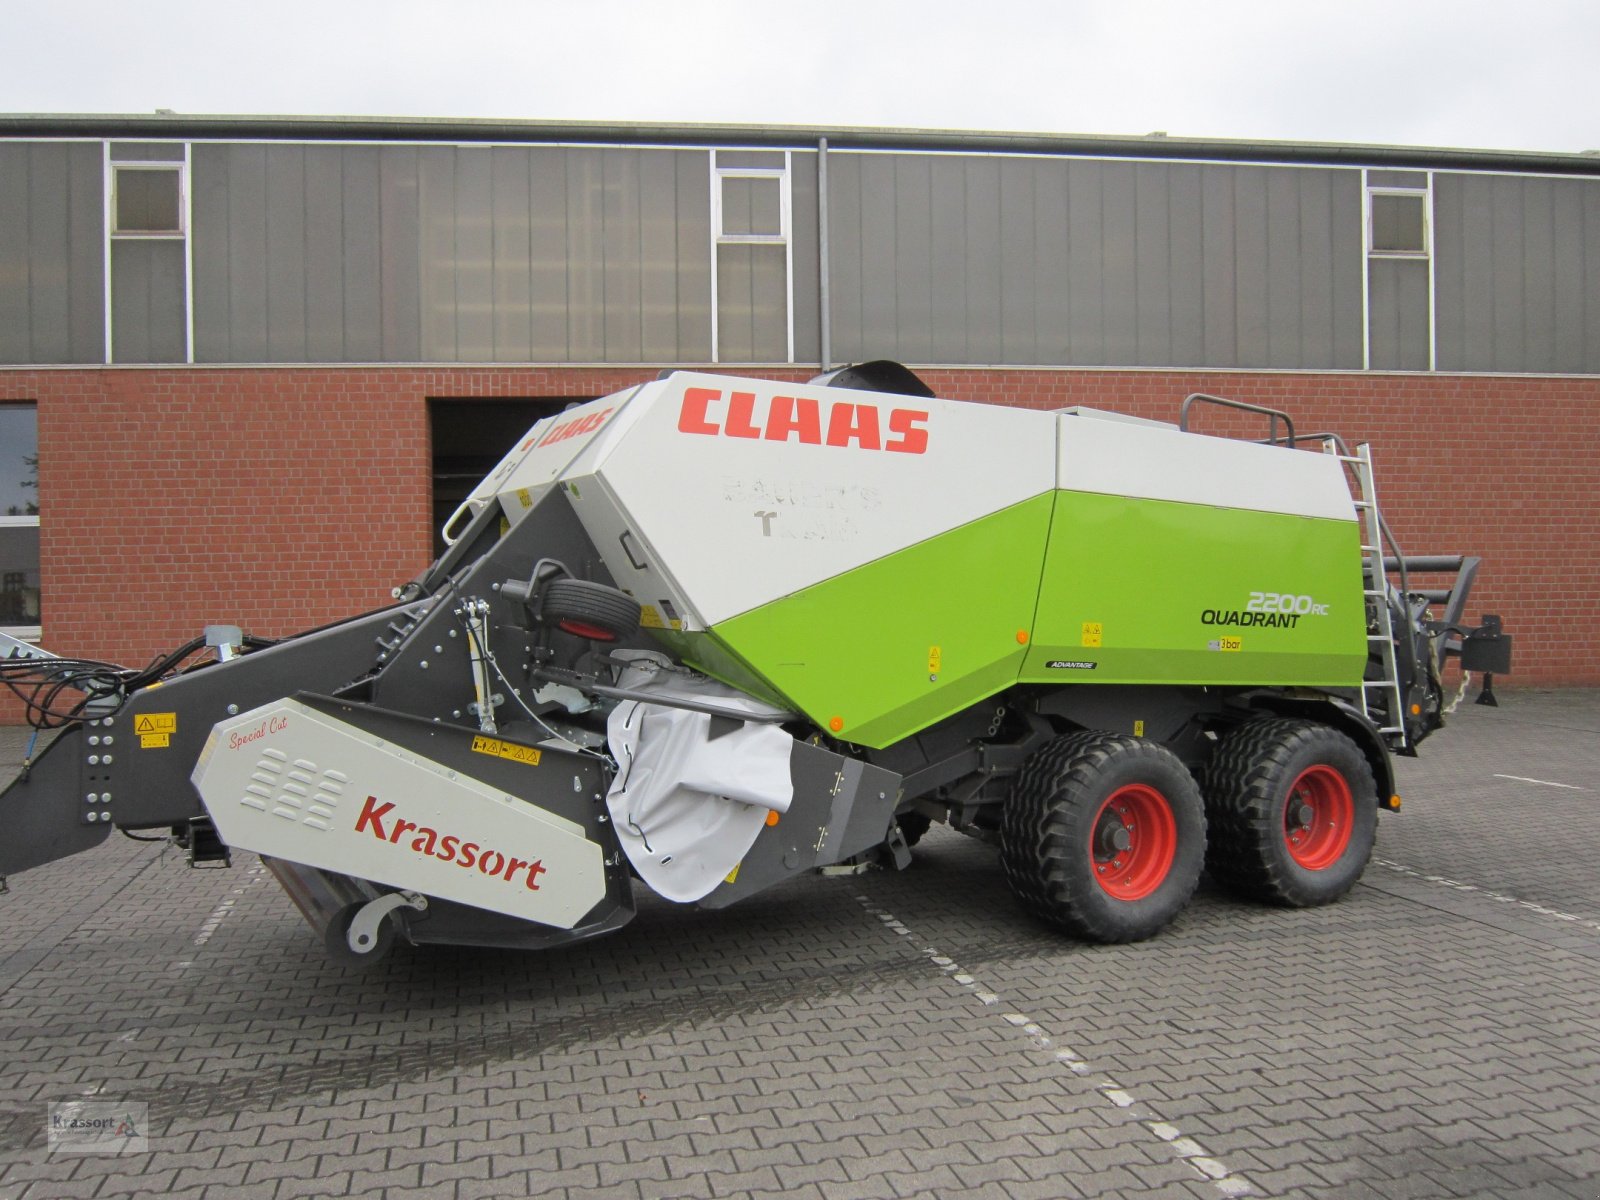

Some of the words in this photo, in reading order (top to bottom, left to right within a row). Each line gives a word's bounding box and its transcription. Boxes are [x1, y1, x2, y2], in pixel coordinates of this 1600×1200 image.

[537, 407, 615, 449] CLAAS
[677, 387, 930, 455] CLAAS
[1201, 609, 1301, 628] QUADRANT
[1051, 661, 1094, 669] ADVANTAGE
[229, 721, 267, 751] Special
[269, 716, 289, 734] Cut
[354, 795, 547, 891] Krassort
